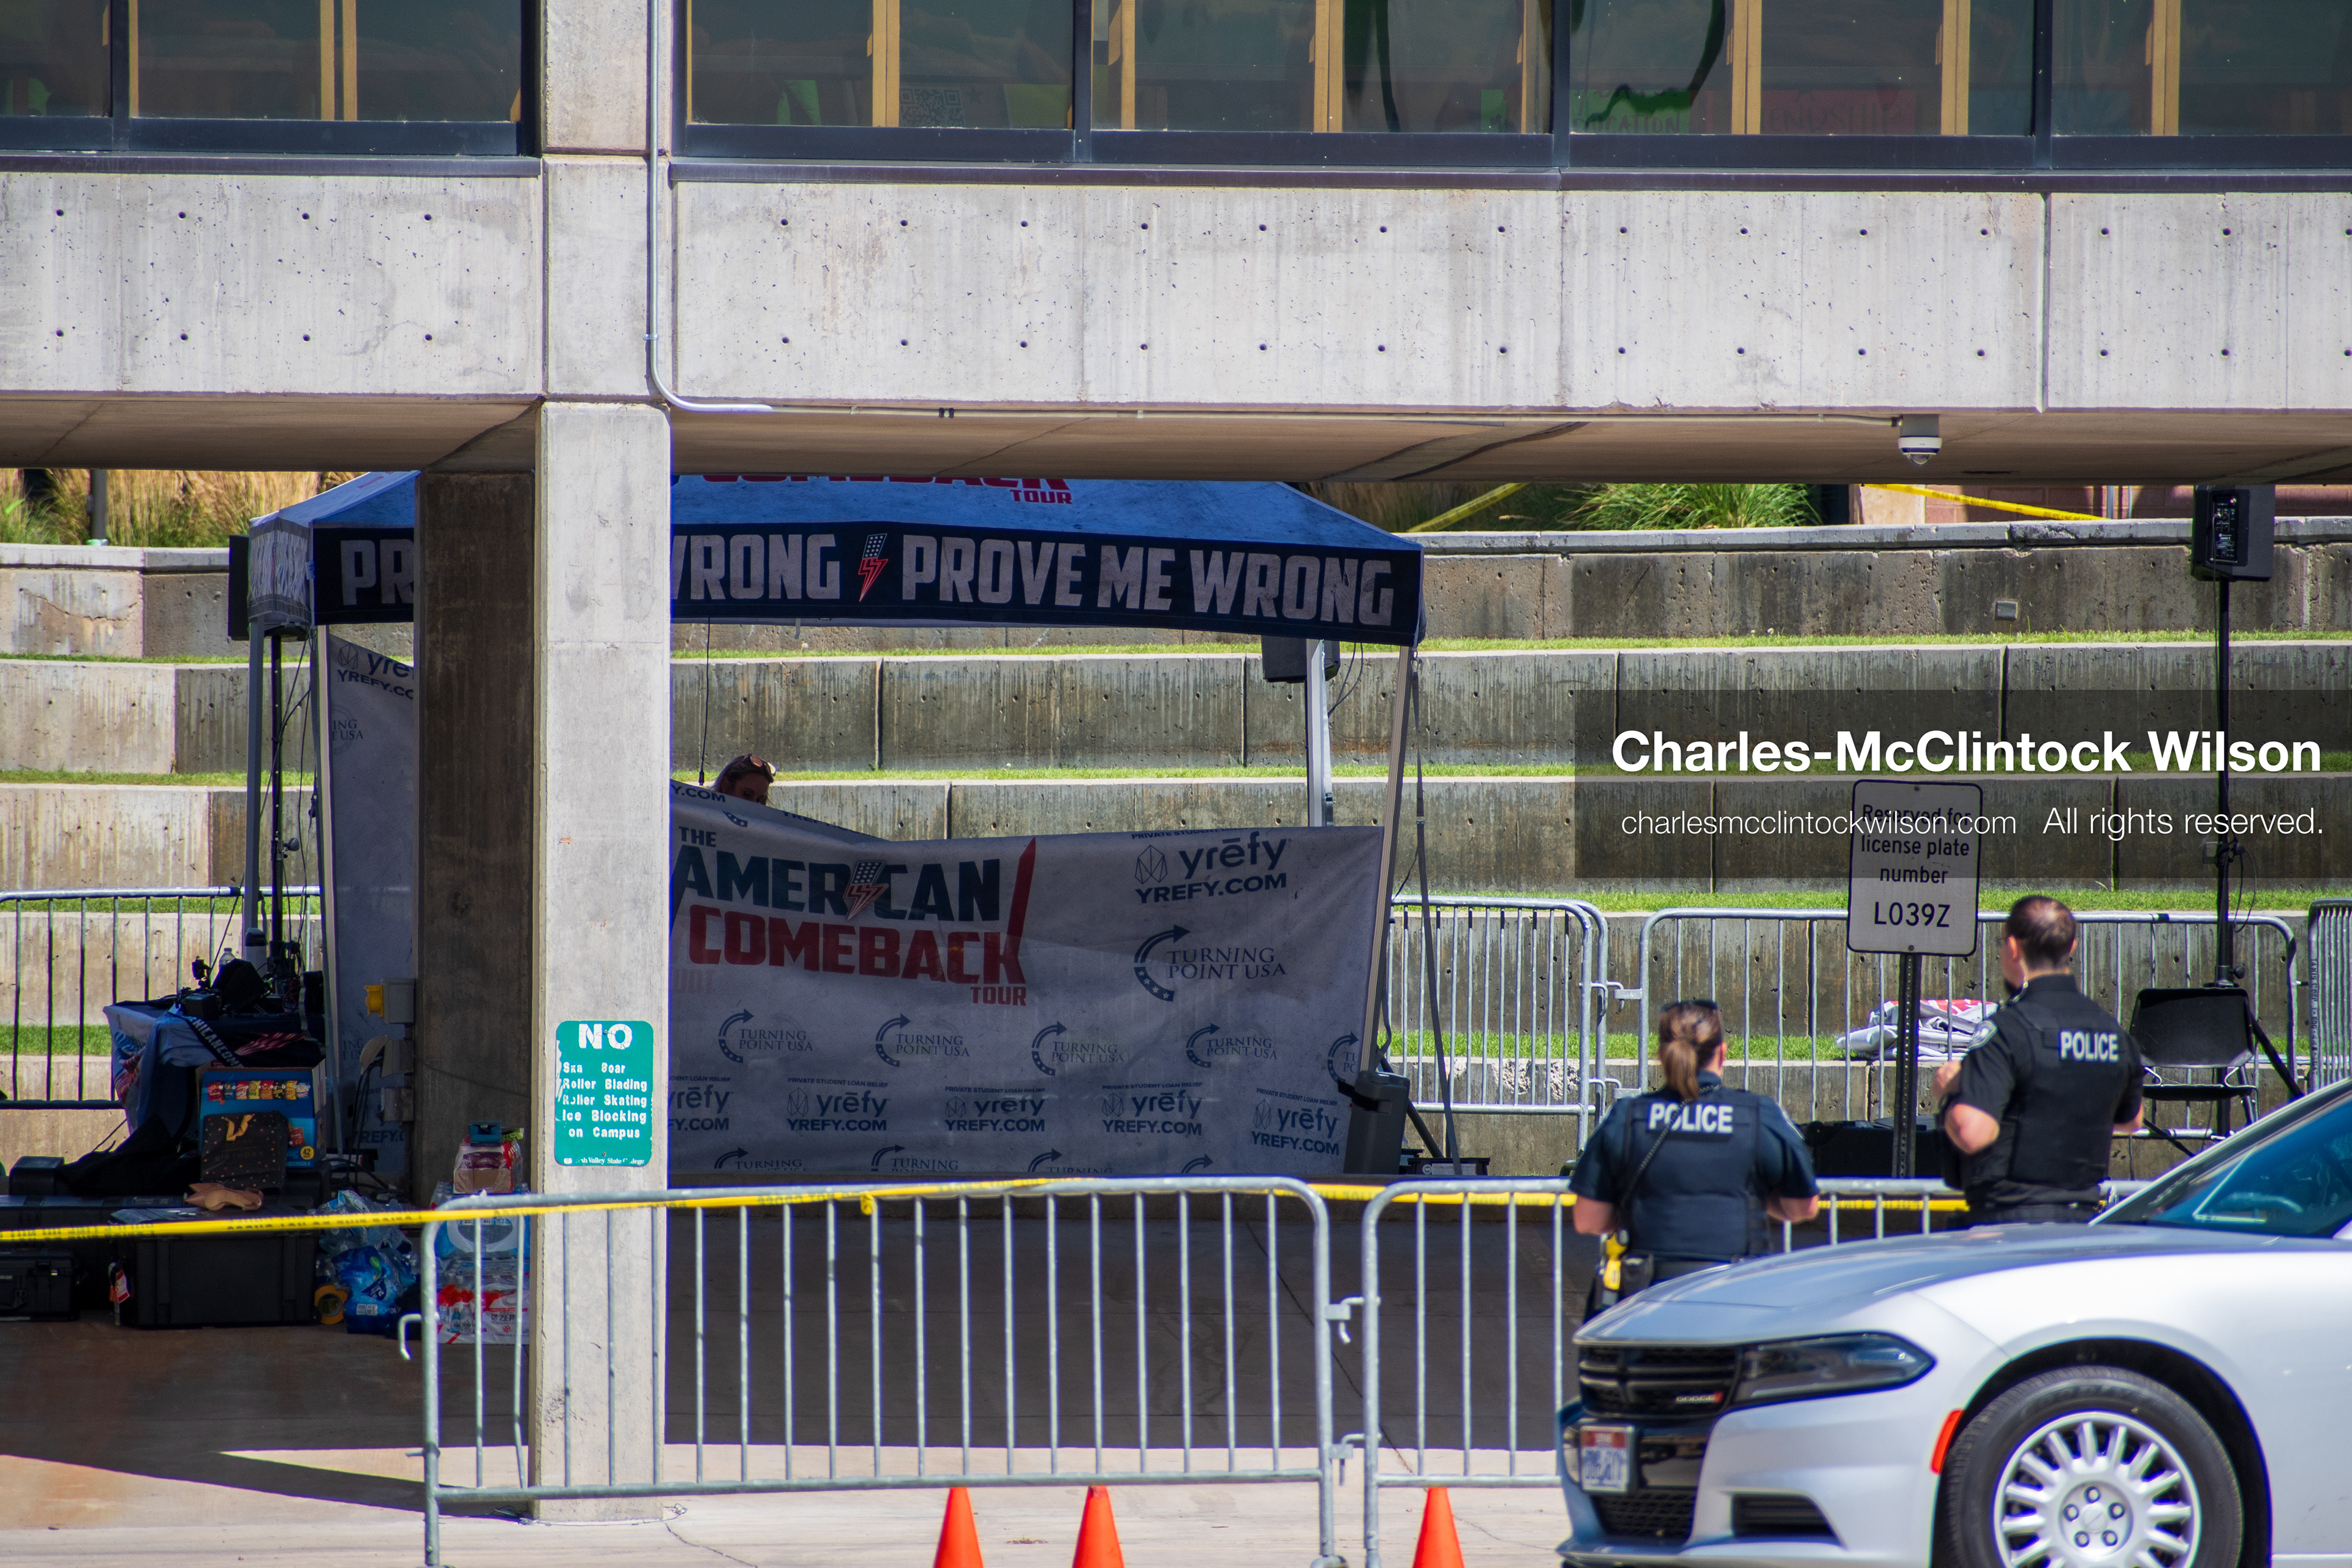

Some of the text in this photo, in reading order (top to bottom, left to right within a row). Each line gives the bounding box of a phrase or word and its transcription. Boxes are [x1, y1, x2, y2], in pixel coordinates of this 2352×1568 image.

[1009, 489, 1072, 504] TOUR
[902, 534, 1394, 626] PROVE ME WRONG
[1863, 804, 1972, 826] Reserved for
[678, 826, 717, 848] THE
[1861, 835, 1970, 859] license plate
[1880, 865, 1948, 884] number
[1135, 873, 1287, 903] YREFY.COM
[689, 837, 1036, 984] COMEBACK
[1874, 901, 1951, 927] L039Z
[1167, 947, 1275, 964] TURNING
[1168, 962, 1287, 980] POINT USA
[970, 986, 1027, 1006] TOUR
[578, 1023, 633, 1050] NO
[739, 1028, 807, 1041] TURNING
[895, 1033, 963, 1046] TURNING
[1205, 1036, 1273, 1048] TURNING
[739, 1039, 813, 1051] POINT USA
[895, 1044, 970, 1057] POINT USA
[1052, 1041, 1118, 1054] TURNING
[2059, 1030, 2119, 1063] POLICE
[1051, 1051, 1125, 1063] POINT USA
[1206, 1046, 1278, 1060] POINT USA
[563, 1078, 647, 1092] Roller Blading
[603, 1094, 647, 1108] Skating
[1256, 1088, 1278, 1097] PRIVATE
[1279, 1092, 1303, 1101] STUDENT
[562, 1109, 647, 1125] Ice Blocking
[787, 1118, 887, 1131] YREFY.COM
[1648, 1103, 1735, 1134] POLICE
[568, 1126, 640, 1140] on Campus
[944, 1119, 1045, 1132] YREFY.COM
[1102, 1120, 1202, 1136] YREFY.COM
[1251, 1131, 1340, 1156] YREFY.COM
[588, 1156, 605, 1165] Valley
[736, 1159, 802, 1170] TURNING
[891, 1158, 959, 1171] TURNING
